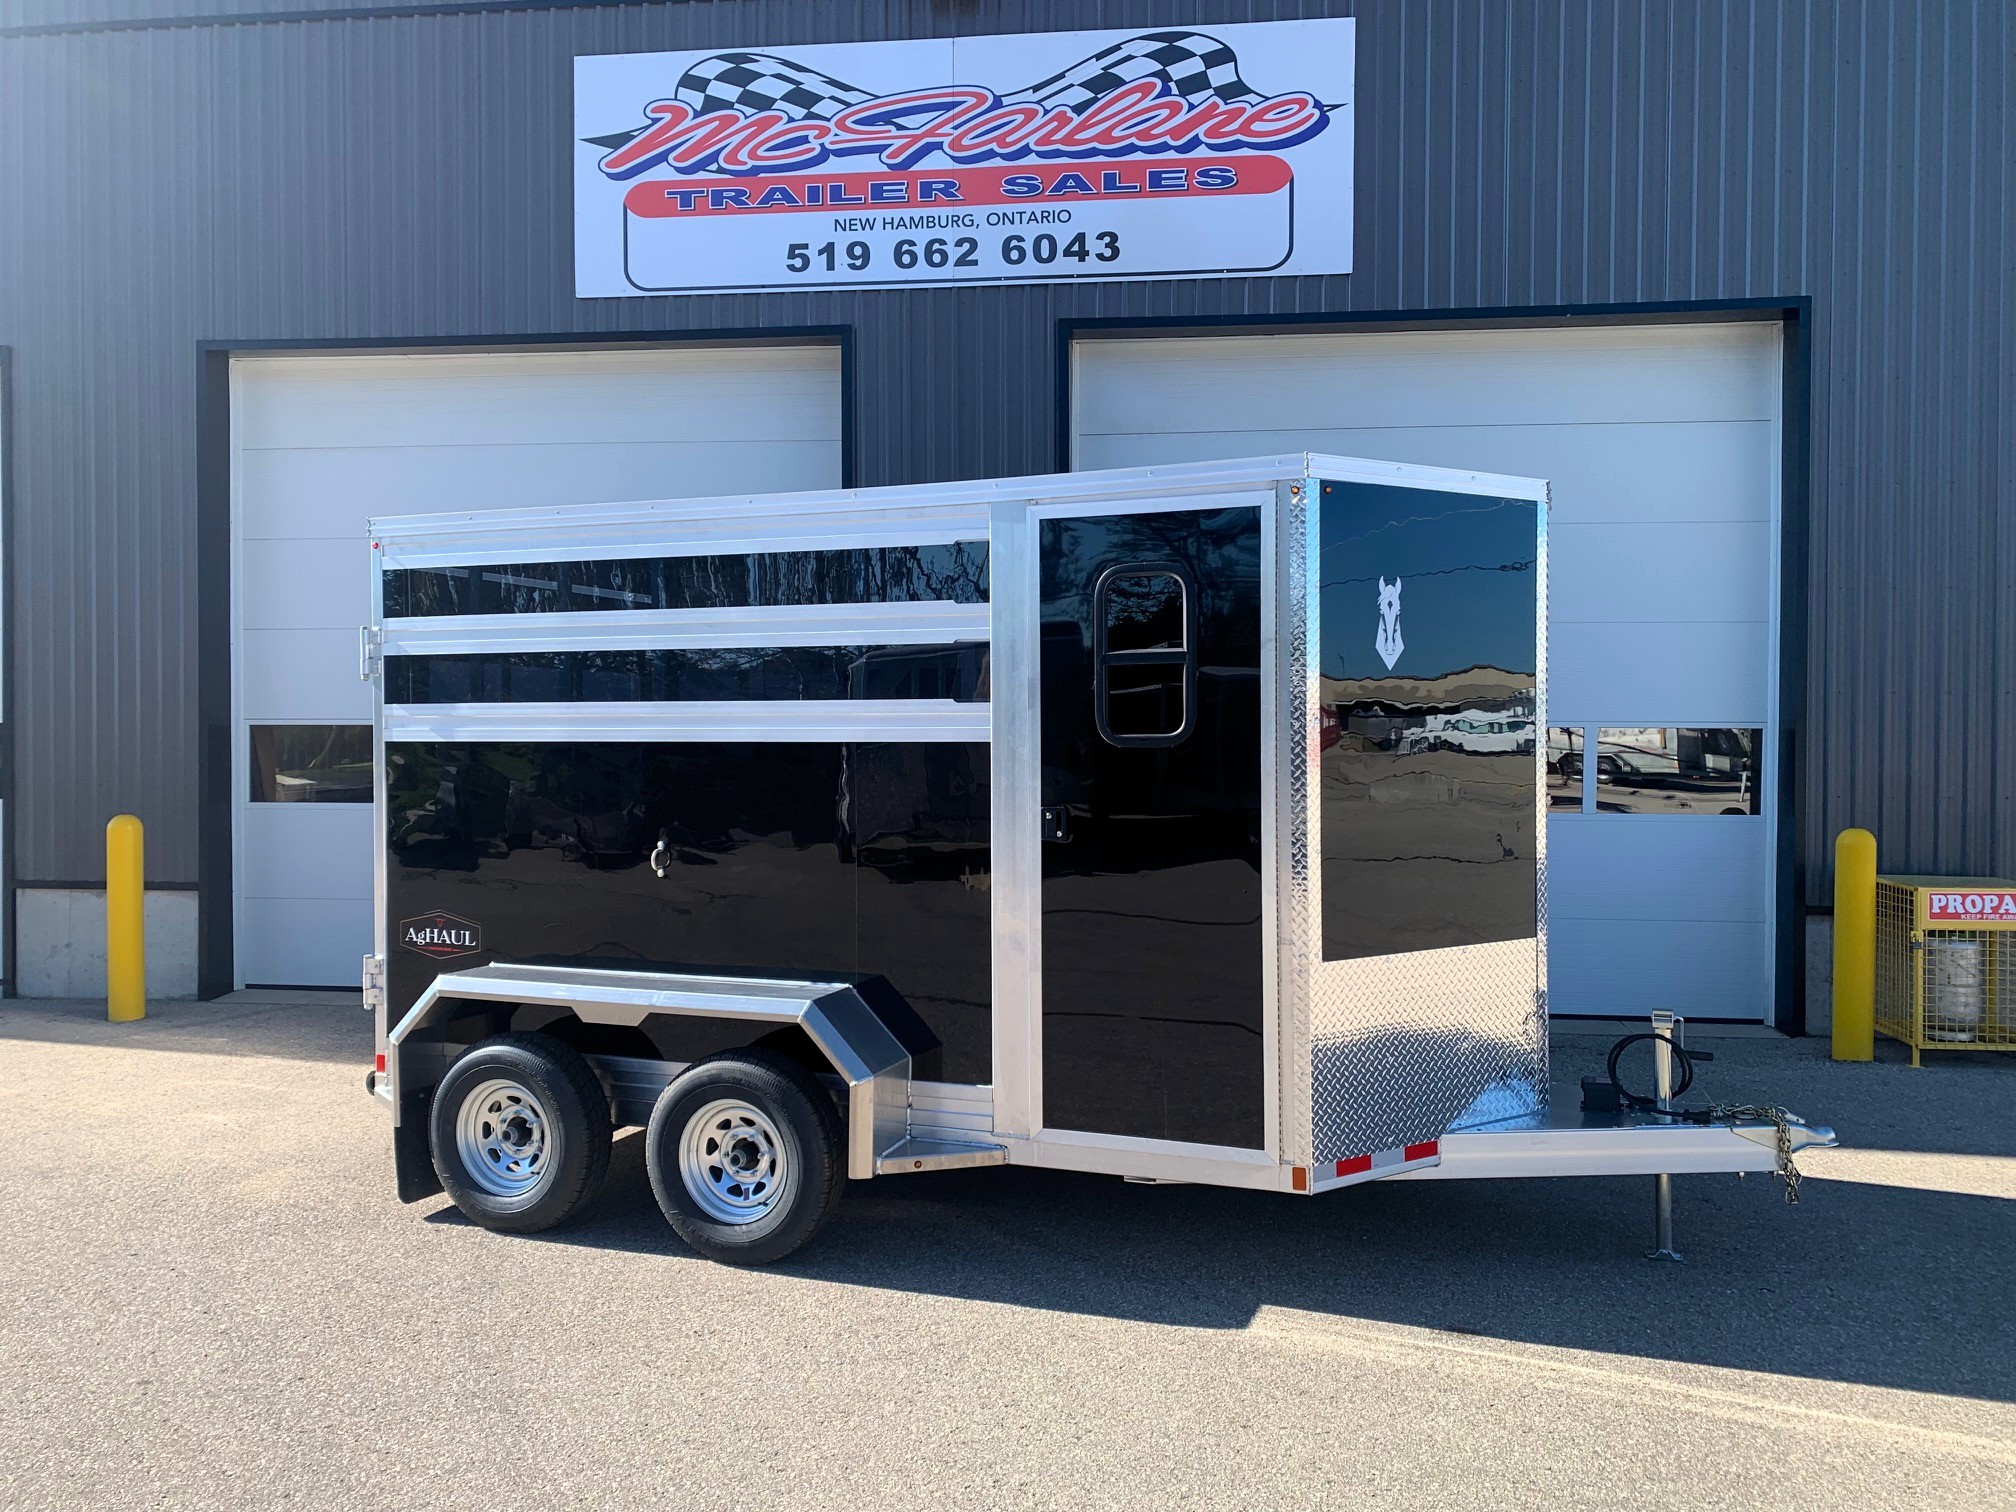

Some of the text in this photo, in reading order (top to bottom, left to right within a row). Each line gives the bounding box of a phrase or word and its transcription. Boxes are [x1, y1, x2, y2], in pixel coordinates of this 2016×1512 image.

[598, 77, 1330, 180] McFarlane
[665, 165, 1238, 211] TRAILER SALES
[834, 209, 1072, 232] NEW HAMBURG, ONTARIO
[786, 231, 1121, 272] 519 662 6043
[405, 927, 476, 946] AgHAUL
